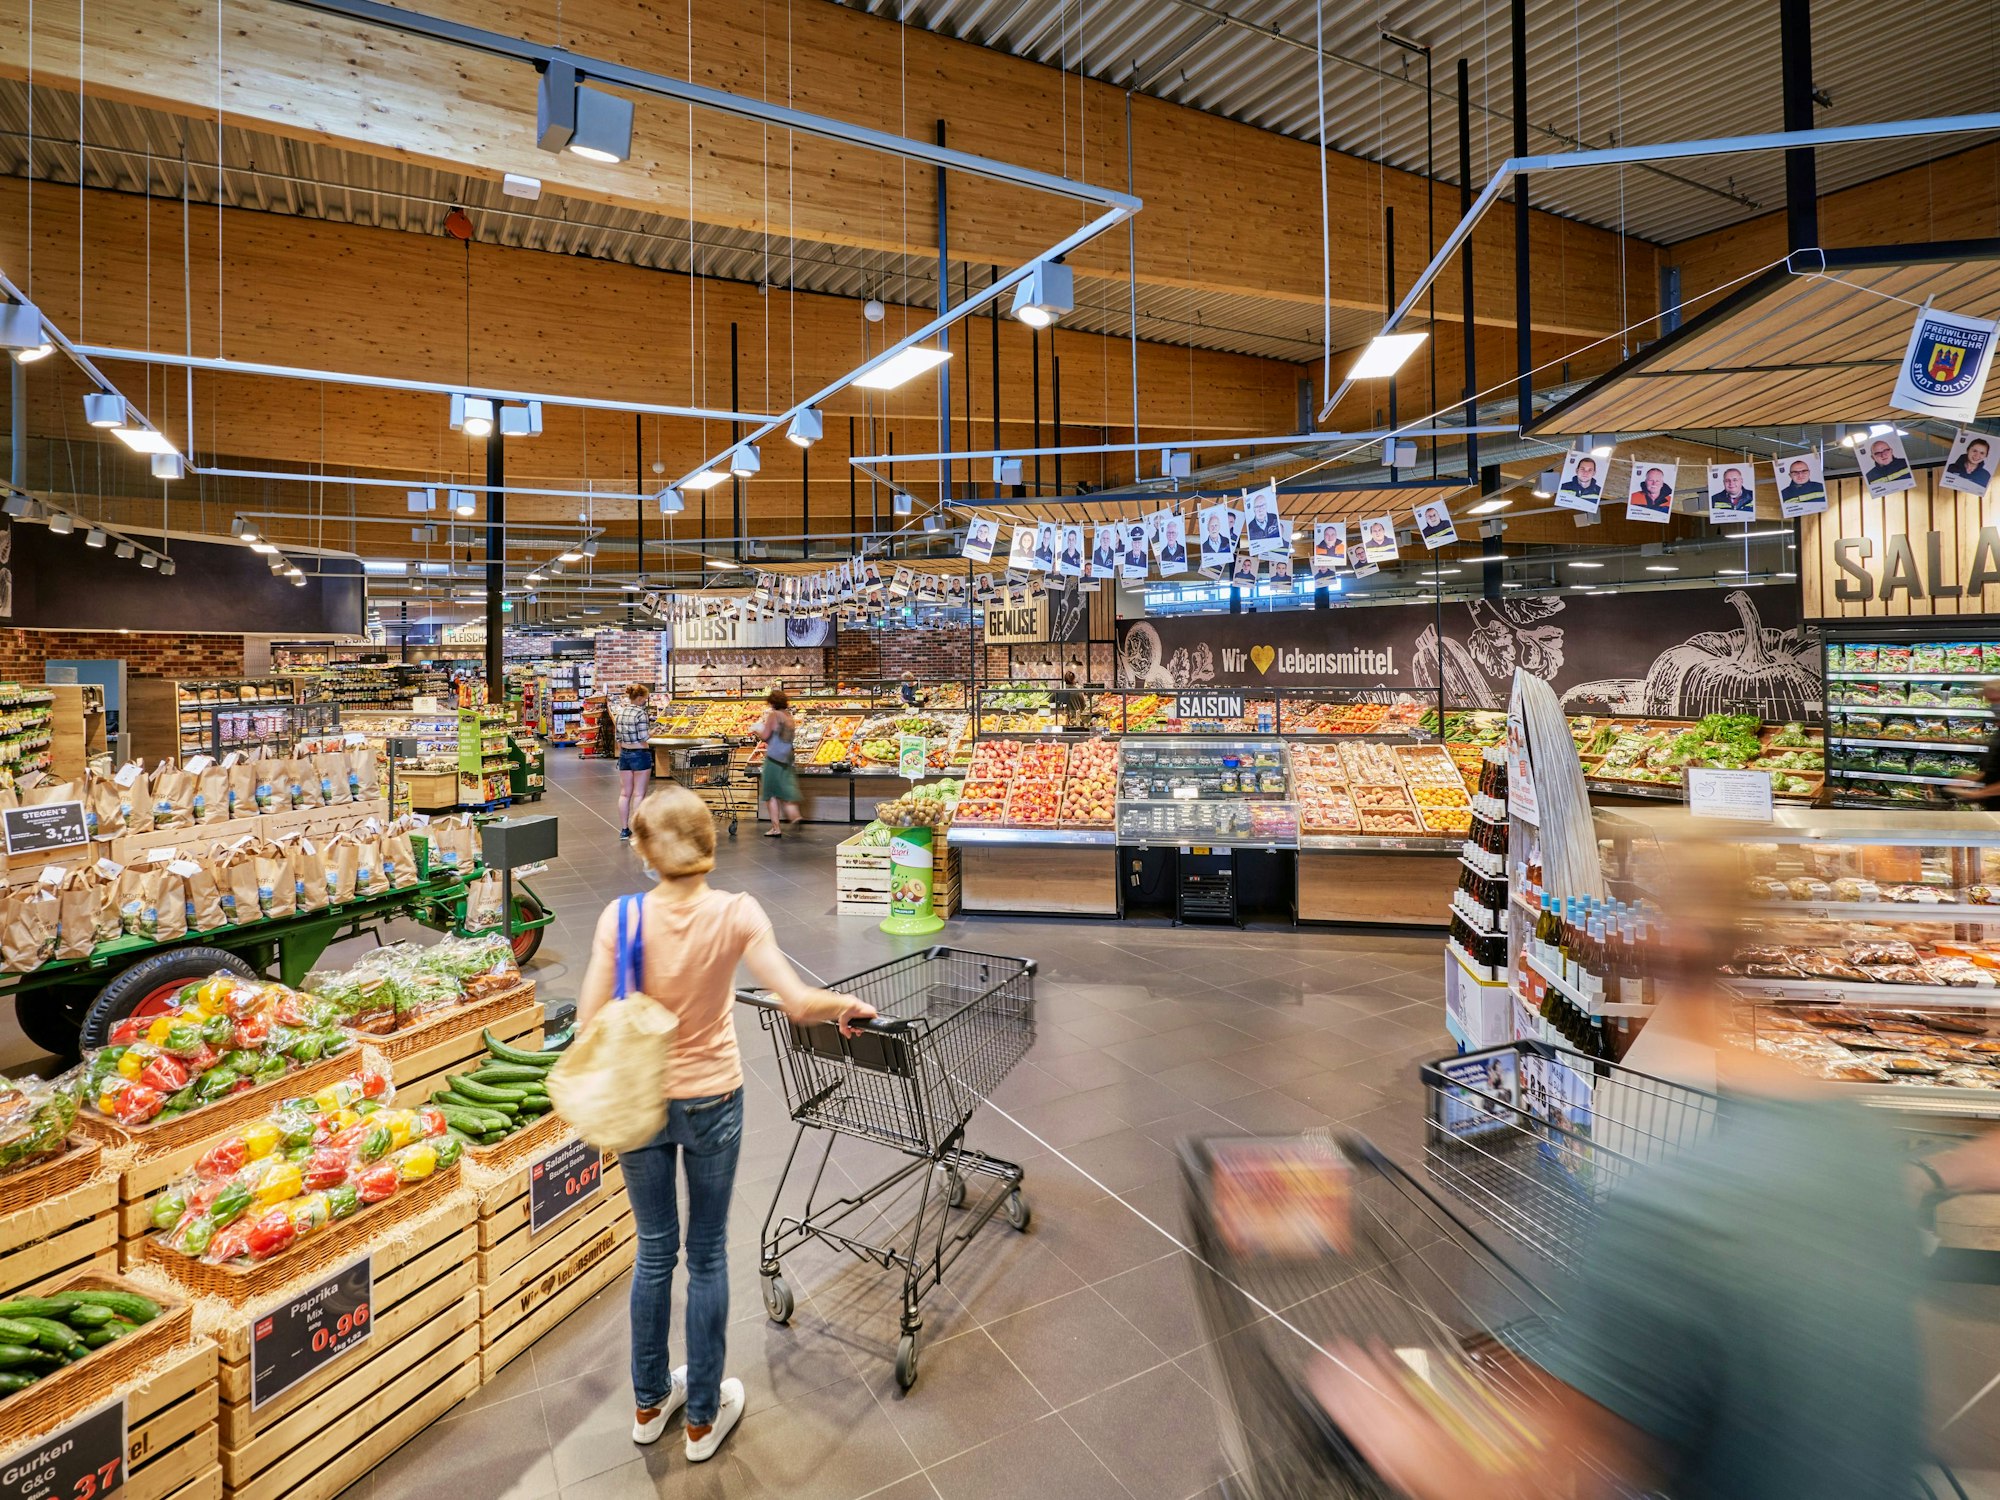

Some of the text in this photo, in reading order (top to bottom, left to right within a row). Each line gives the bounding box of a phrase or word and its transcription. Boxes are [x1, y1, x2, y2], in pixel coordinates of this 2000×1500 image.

[1924, 332, 1982, 349] FEUERWEHR
[1926, 324, 1985, 342] FREIWILLIGE
[1914, 362, 1972, 392] STADT SOLTAU
[1222, 647, 1399, 675] Wir Lebensmittel.
[1180, 697, 1240, 716] SAISON
[45, 824, 81, 840] 3,71
[565, 1160, 599, 1195] 0,67
[290, 1283, 338, 1319] Paprika
[521, 1291, 538, 1312] Wir
[306, 1308, 323, 1324] Mix
[312, 1303, 369, 1352] 0,96
[2, 1439, 73, 1485] Gurken
[21, 1467, 56, 1494] G&G
